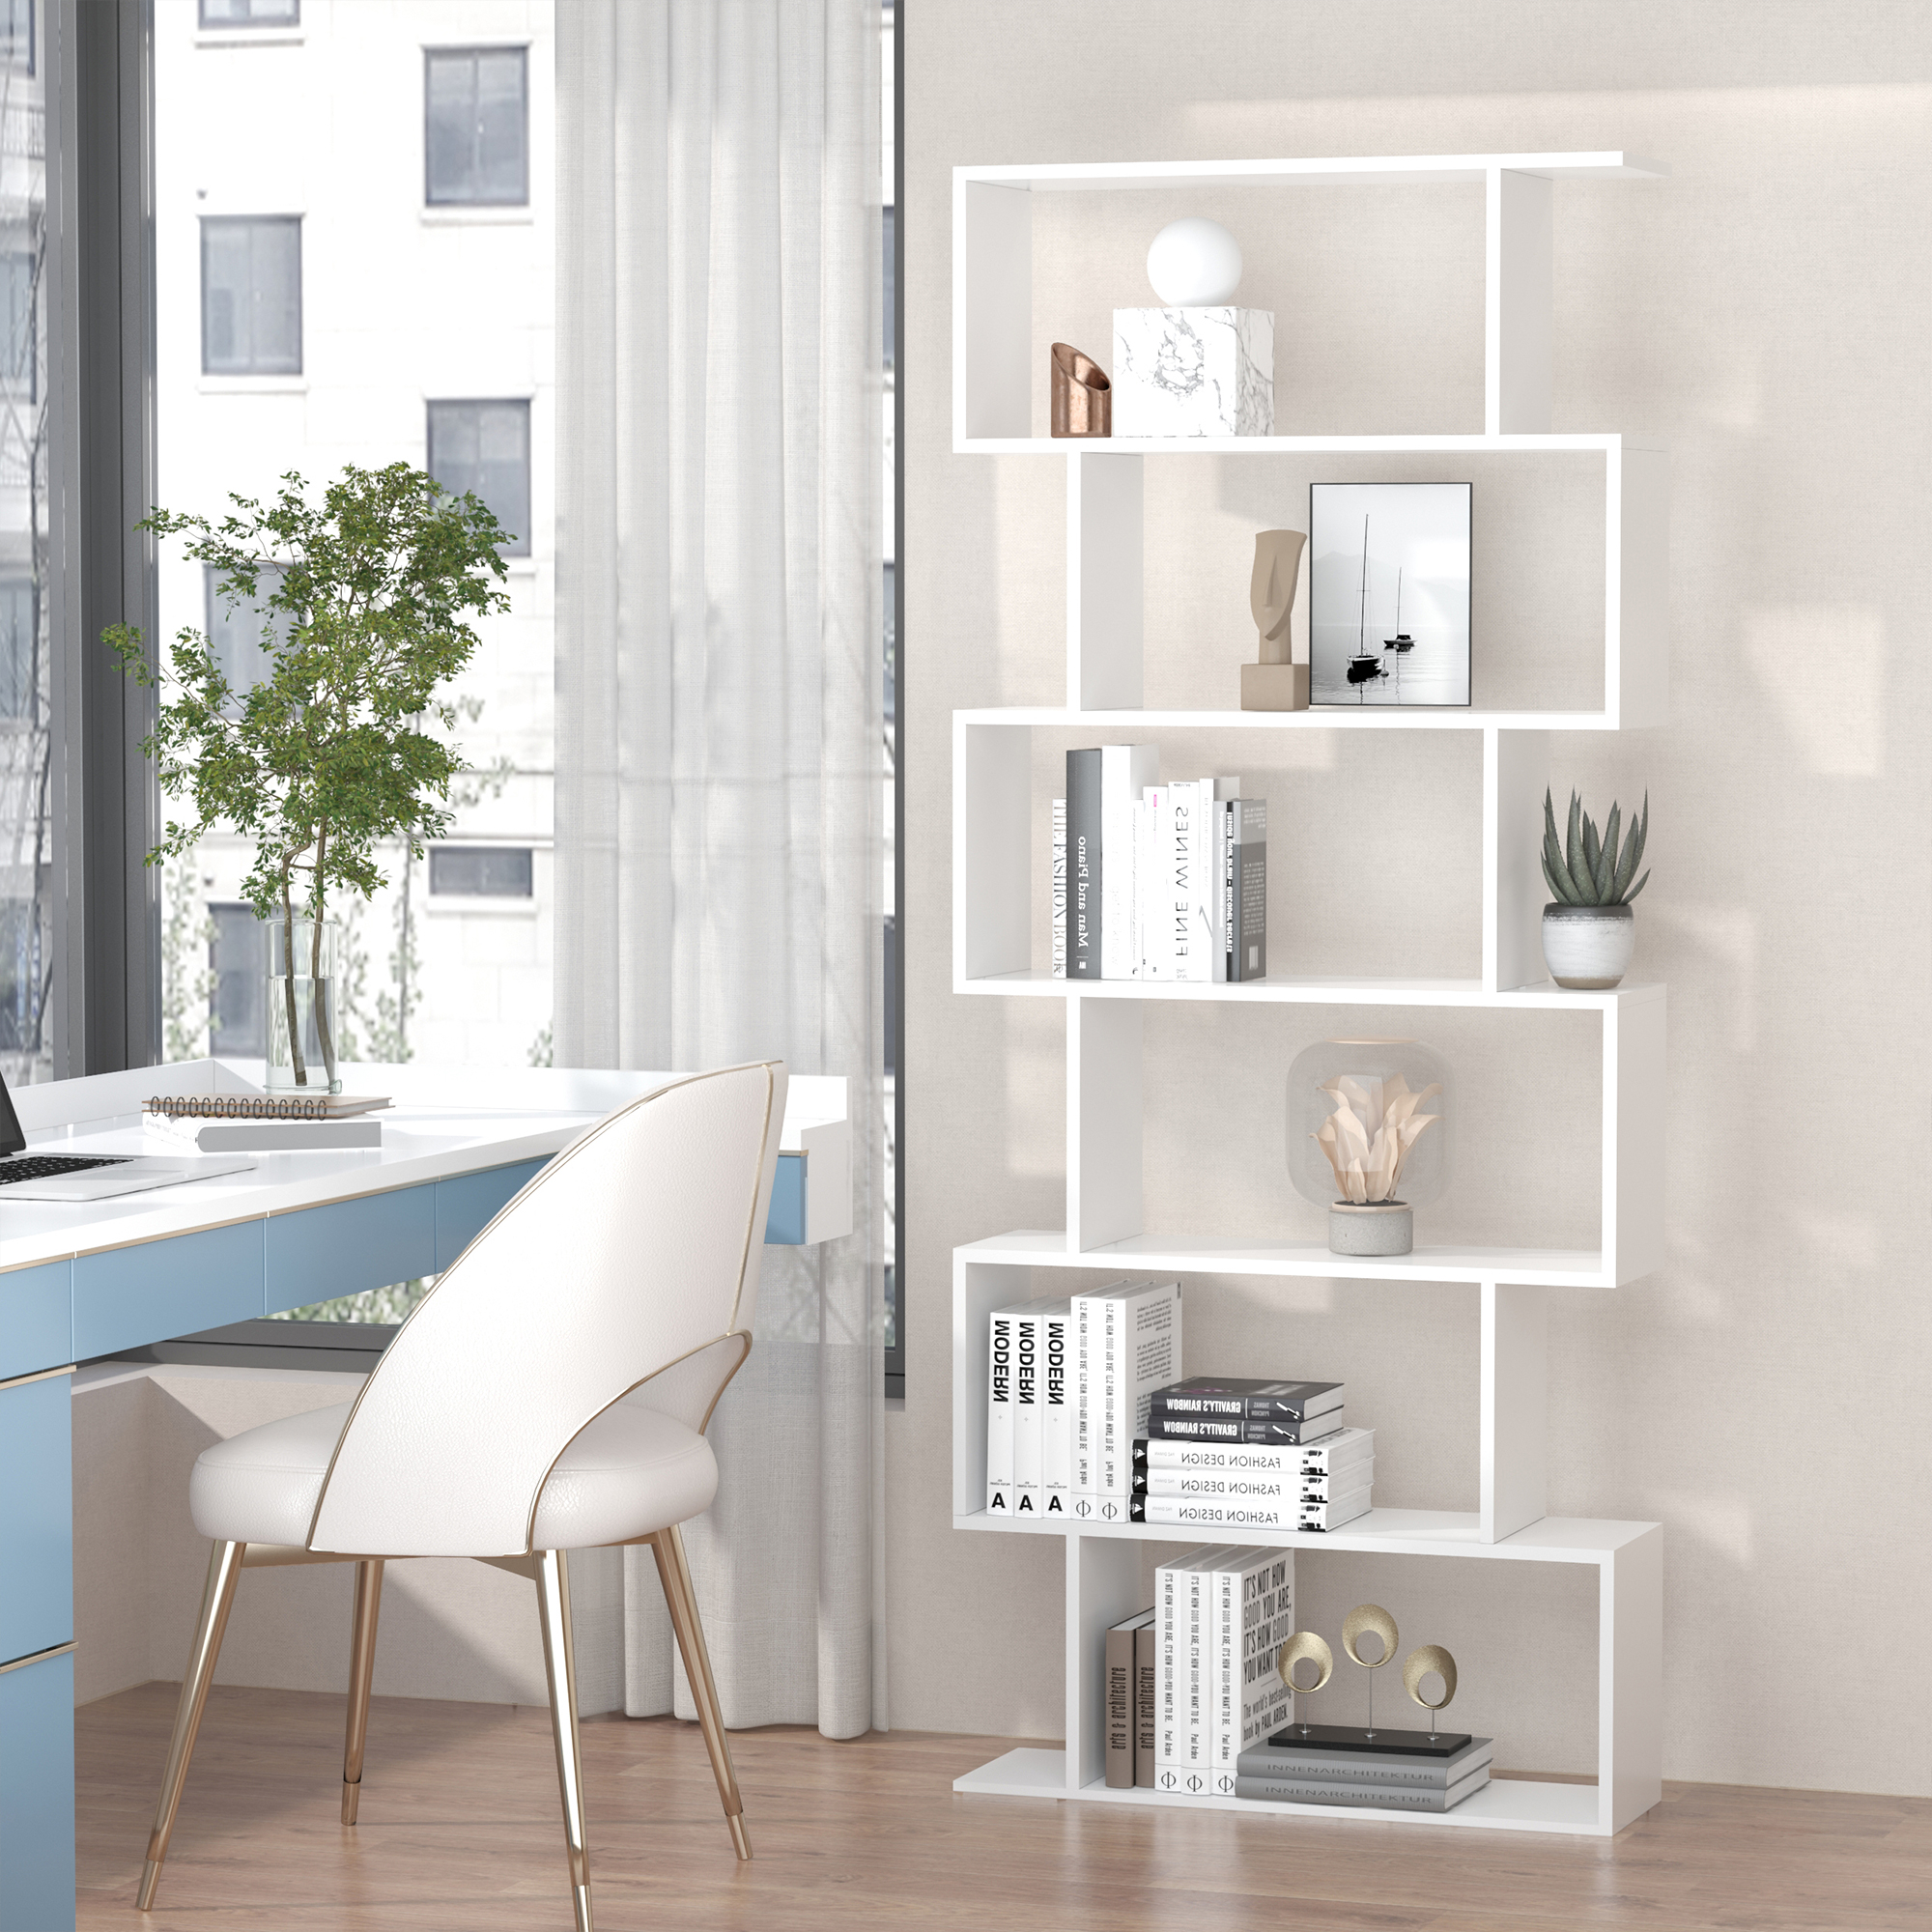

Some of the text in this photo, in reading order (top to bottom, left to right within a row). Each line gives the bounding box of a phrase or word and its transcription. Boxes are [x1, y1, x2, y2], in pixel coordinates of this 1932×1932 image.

[991, 1492, 1007, 1509] A
[1018, 1494, 1034, 1511] A
[1048, 1495, 1063, 1511] A
[1244, 1559, 1286, 1603] IT'S NOT HOW
[1244, 1600, 1260, 1631] GOOD
[1264, 1592, 1275, 1620] YOU
[1244, 1613, 1289, 1658] IT'S HOW GOOD
[1244, 1657, 1256, 1685] YOU
[1257, 1648, 1273, 1678] WANT
[1109, 1667, 1126, 1719] architecture
[1138, 1667, 1154, 1719] architecture
[1244, 1721, 1254, 1741] book
[1262, 1712, 1271, 1731] PAUL
[1109, 1733, 1126, 1750] arts
[1139, 1733, 1154, 1748] arts
[1267, 1764, 1434, 1781] INNENARCHITEKTUR
[1265, 1786, 1432, 1804] INNENARCHITEKTUR
